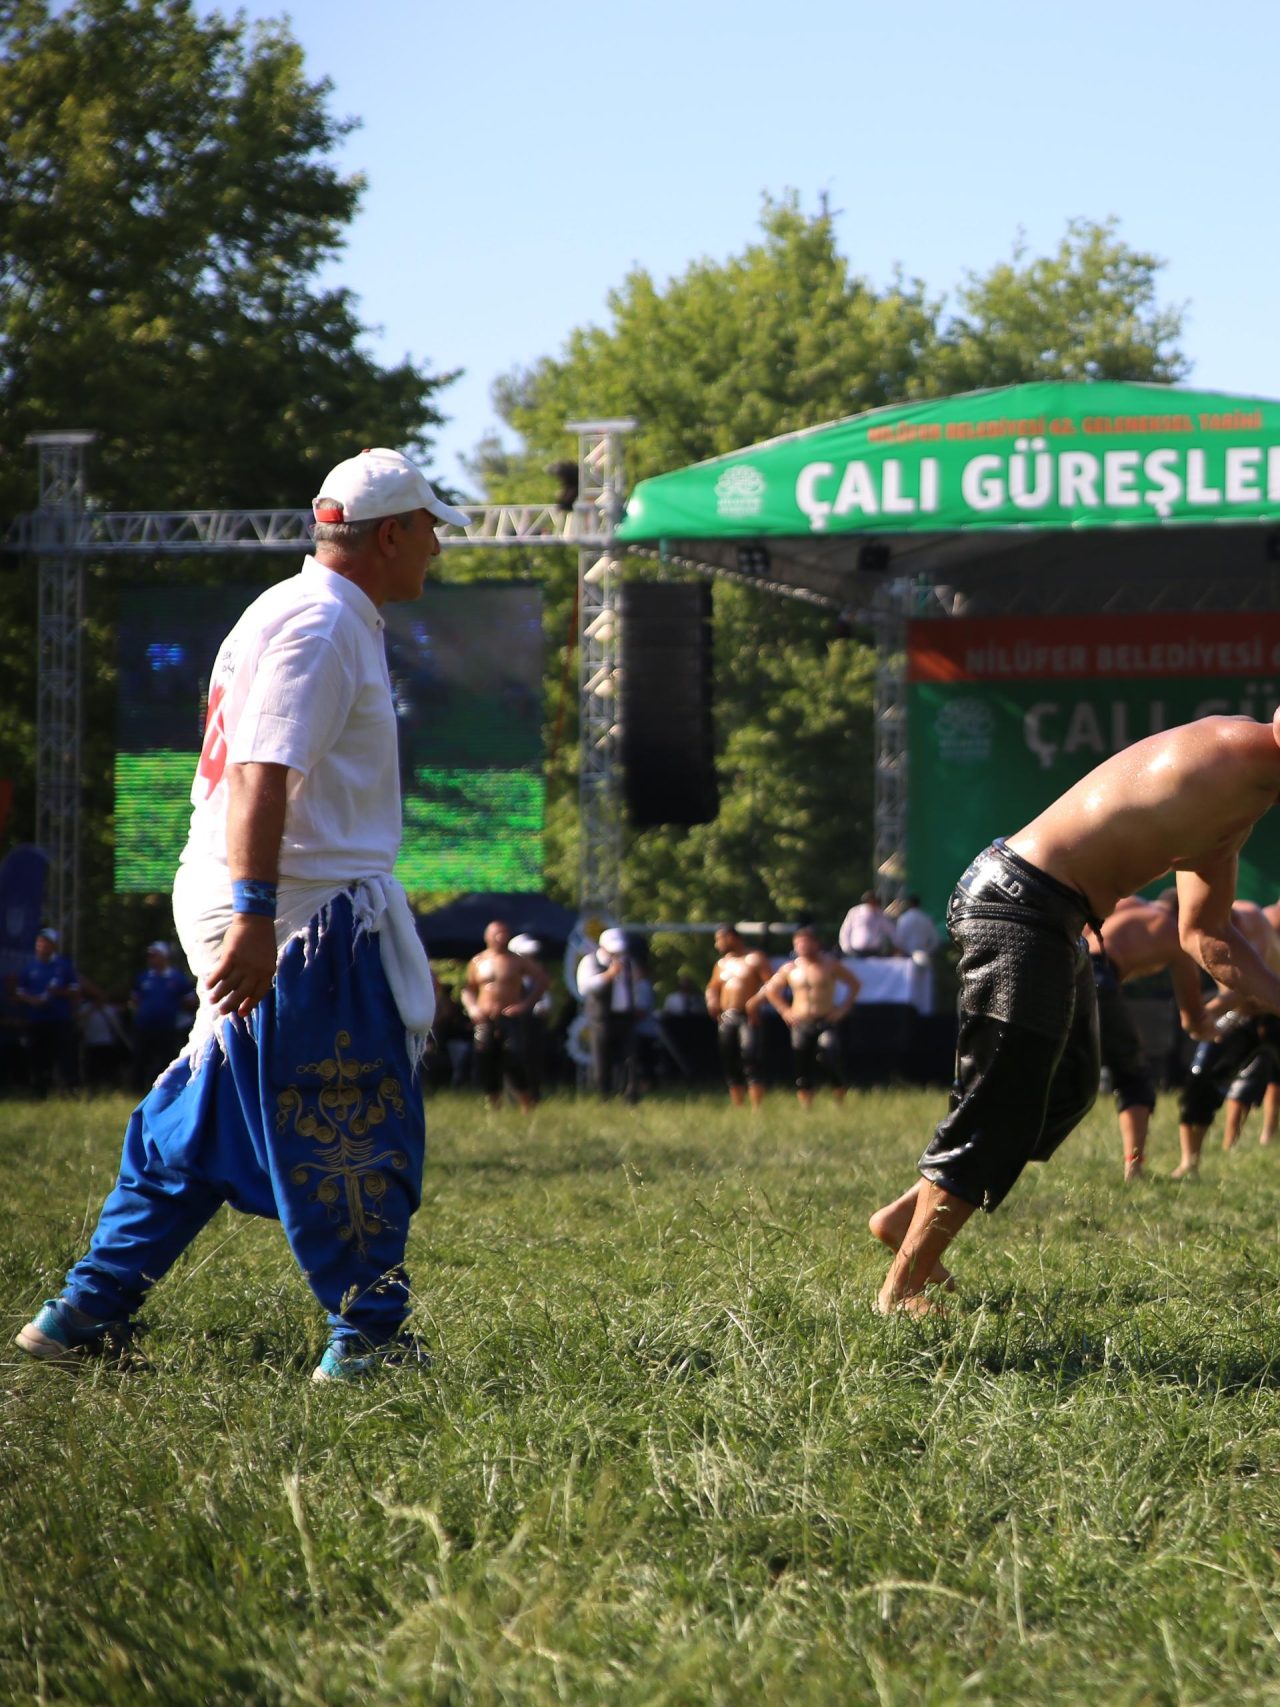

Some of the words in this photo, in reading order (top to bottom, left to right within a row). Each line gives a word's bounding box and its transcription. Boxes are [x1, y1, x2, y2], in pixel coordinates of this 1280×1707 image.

[795, 456, 940, 531] ÇALI
[965, 639, 1089, 674] NİLÜFER
[1095, 637, 1263, 670] BELEDİYESİ
